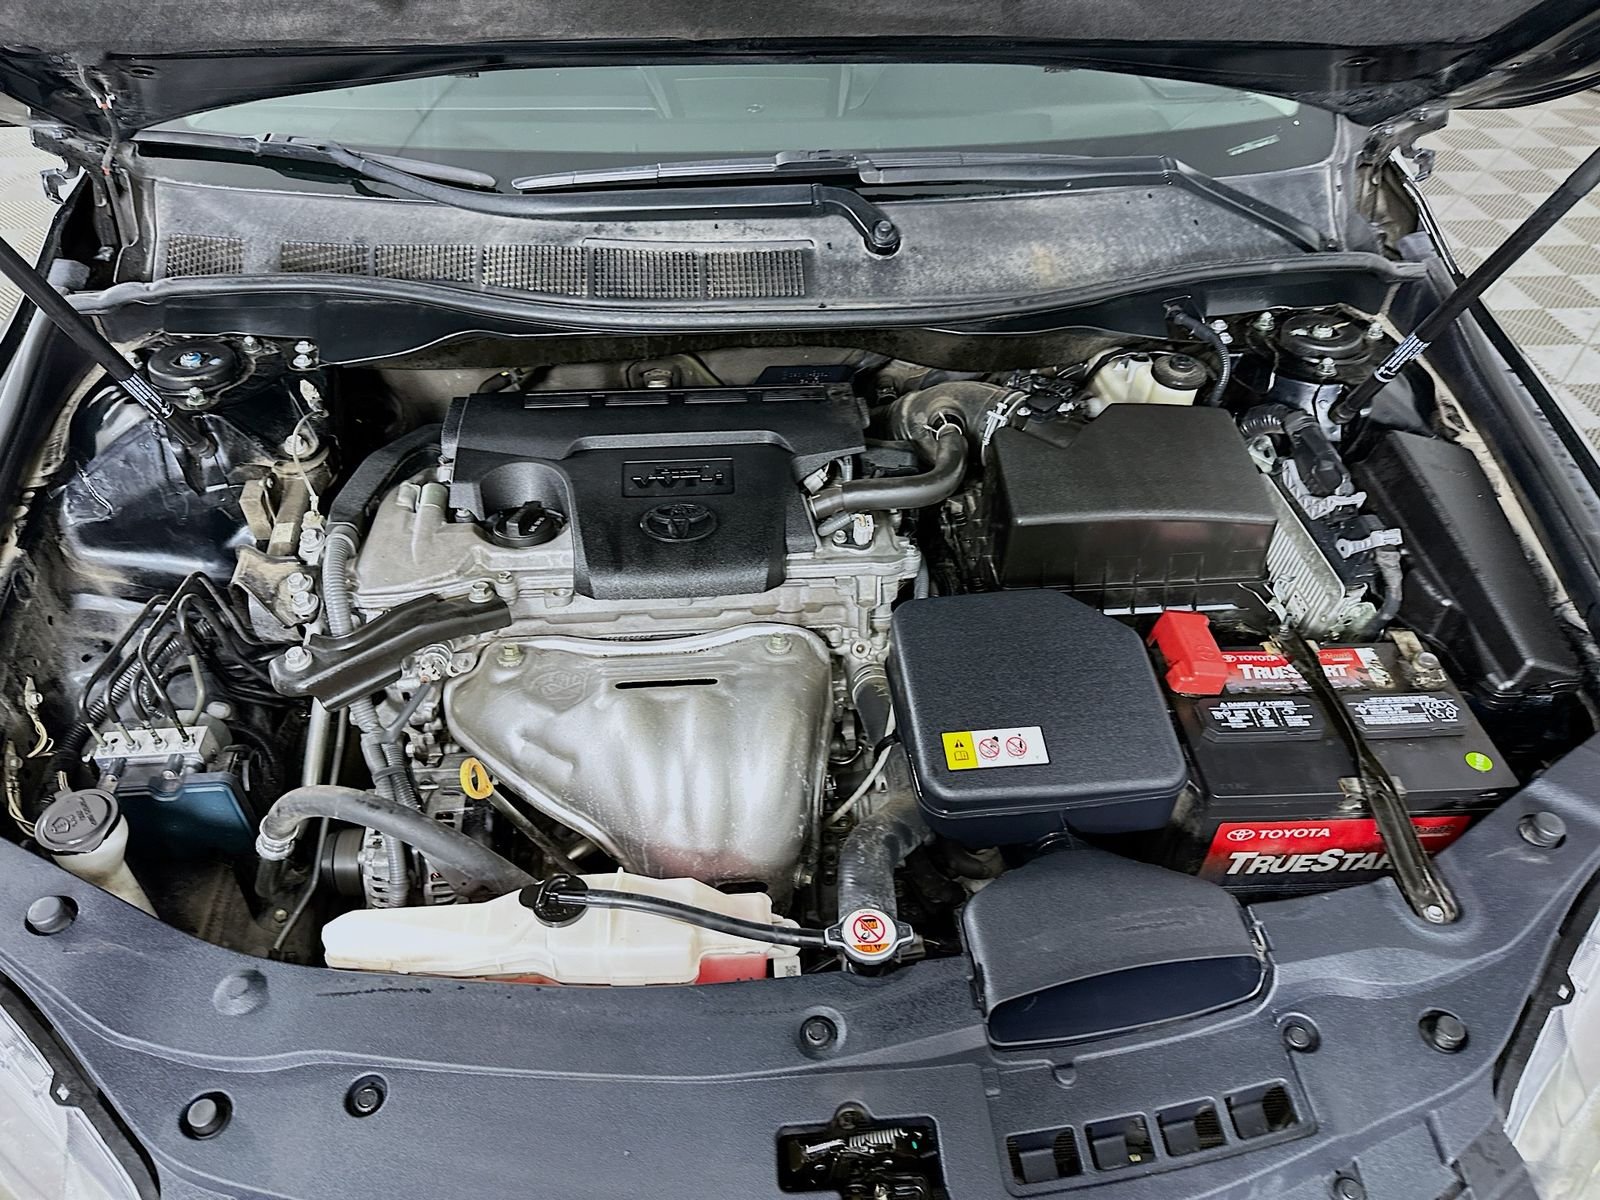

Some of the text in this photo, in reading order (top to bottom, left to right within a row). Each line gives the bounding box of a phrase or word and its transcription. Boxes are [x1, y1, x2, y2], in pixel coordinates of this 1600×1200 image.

[1237, 654, 1280, 662] TOYOTA
[1237, 663, 1350, 680] TRUESRT
[1258, 828, 1331, 839] TOYOTA
[1226, 848, 1396, 875] TRUESTAR
